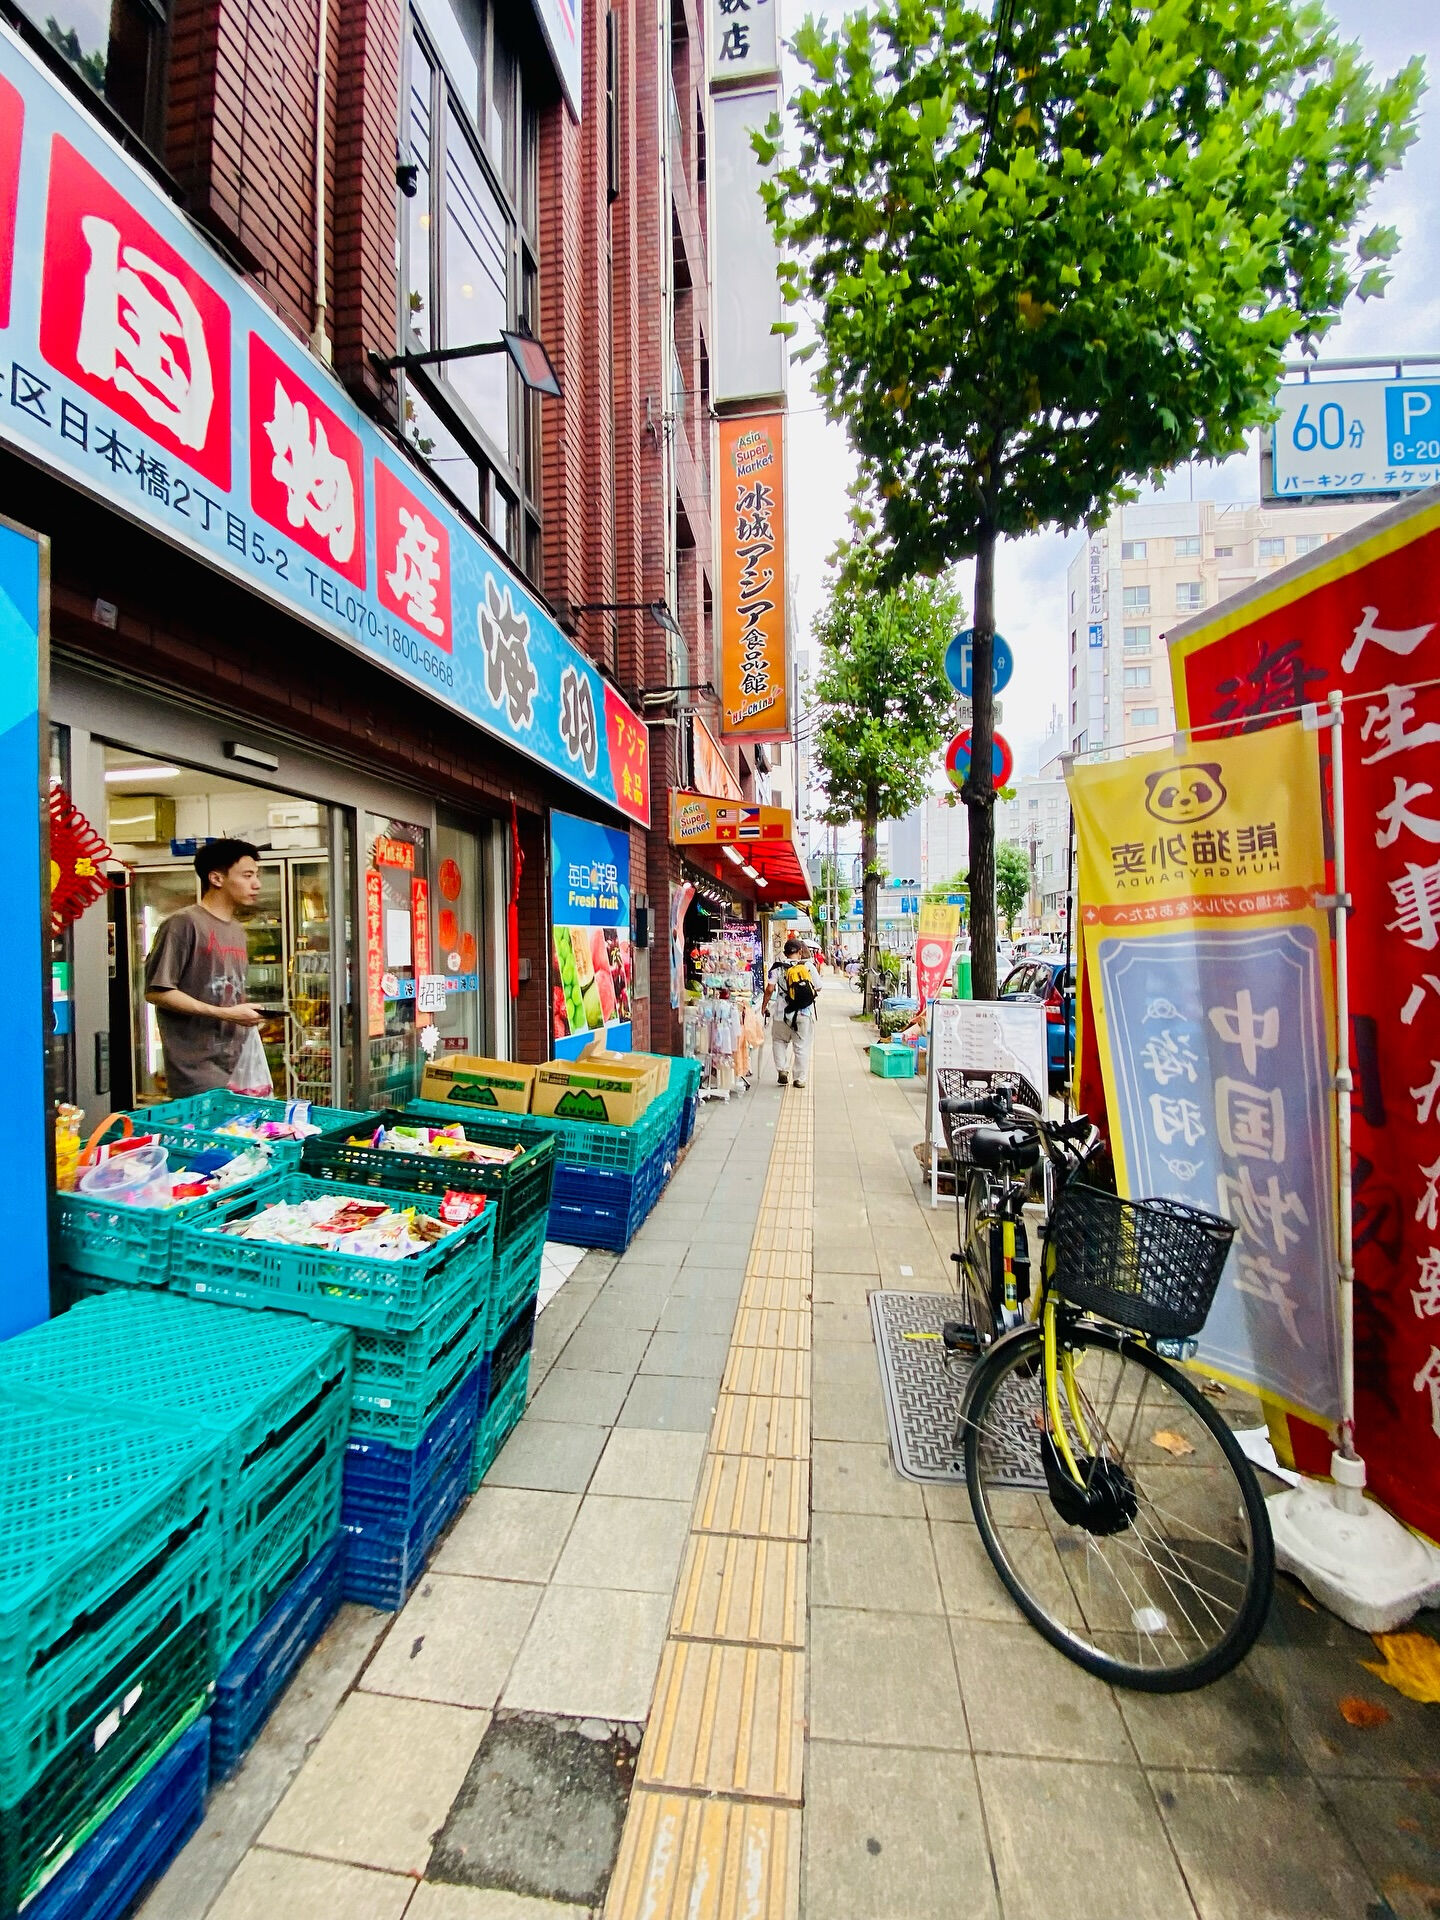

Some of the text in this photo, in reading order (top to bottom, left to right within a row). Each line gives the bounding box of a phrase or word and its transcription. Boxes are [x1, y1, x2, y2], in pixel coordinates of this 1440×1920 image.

[1403, 391, 1432, 436] P
[1293, 402, 1365, 452] 60分
[738, 430, 761, 449] Asia
[736, 443, 767, 464] Super
[737, 453, 774, 478] Market
[0, 362, 454, 688] 区日本橋2丁目5-2 TEL070-1800-6668
[614, 714, 646, 767] アジア
[621, 762, 643, 806] 食品
[682, 802, 701, 815] Asia
[679, 812, 705, 829] Super
[680, 821, 711, 838] Market
[568, 891, 618, 910] Fresh fruit
[597, 1079, 623, 1091] レタス
